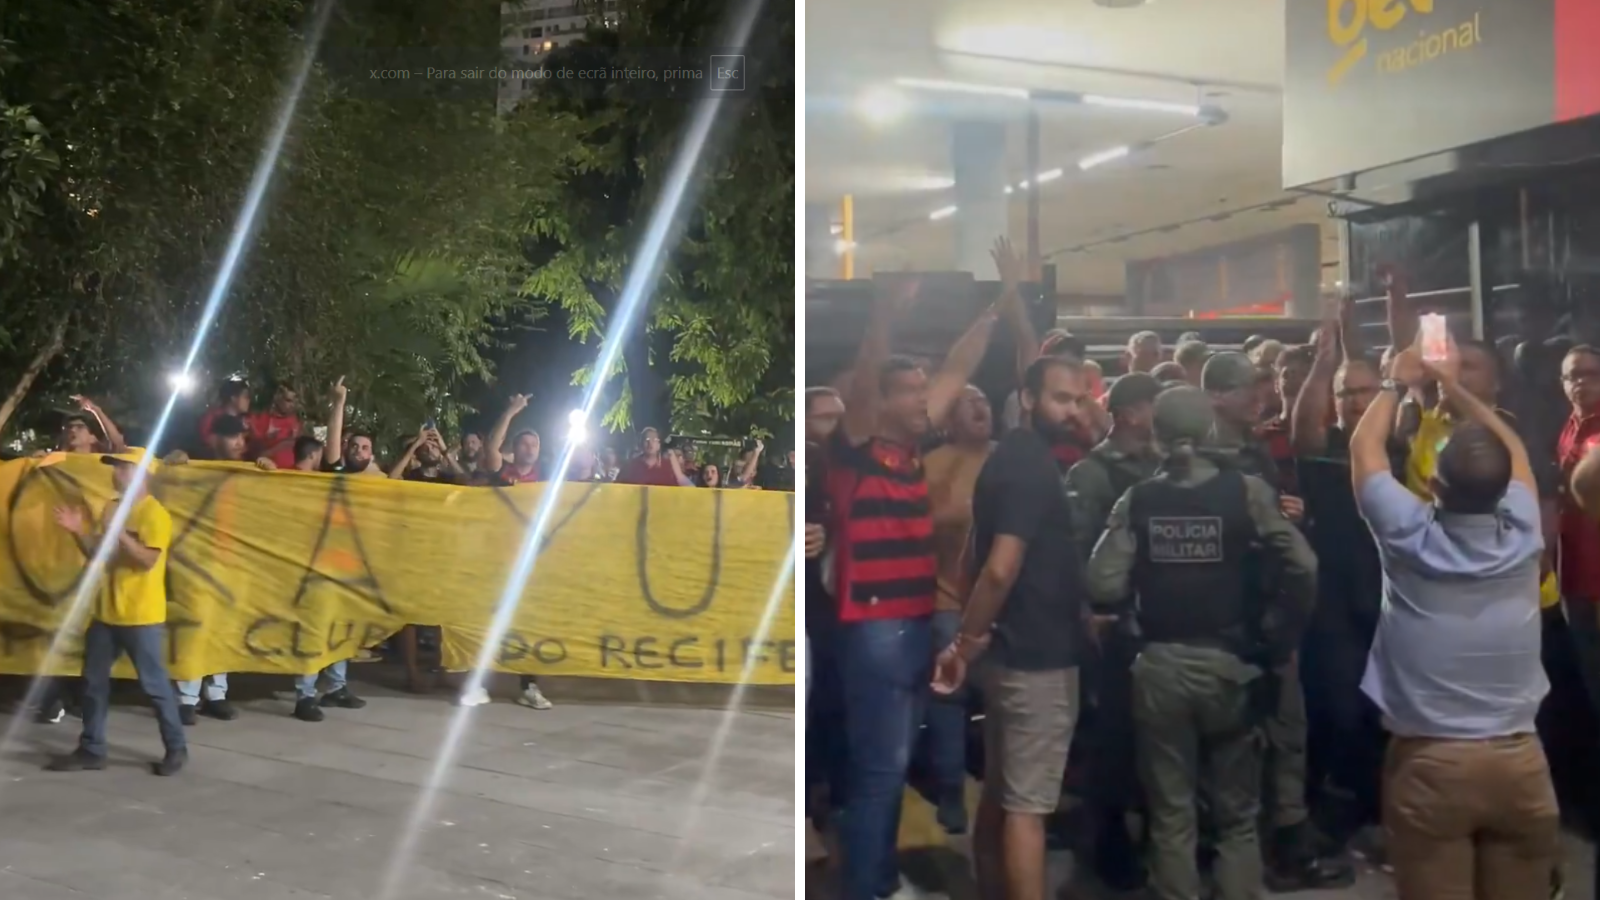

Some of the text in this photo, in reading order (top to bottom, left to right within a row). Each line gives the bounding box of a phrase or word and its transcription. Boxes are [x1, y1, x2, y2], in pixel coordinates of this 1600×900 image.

[1377, 12, 1481, 74] nacional
[1153, 543, 1218, 558] MILITAR
[601, 633, 795, 675] RECIFE
